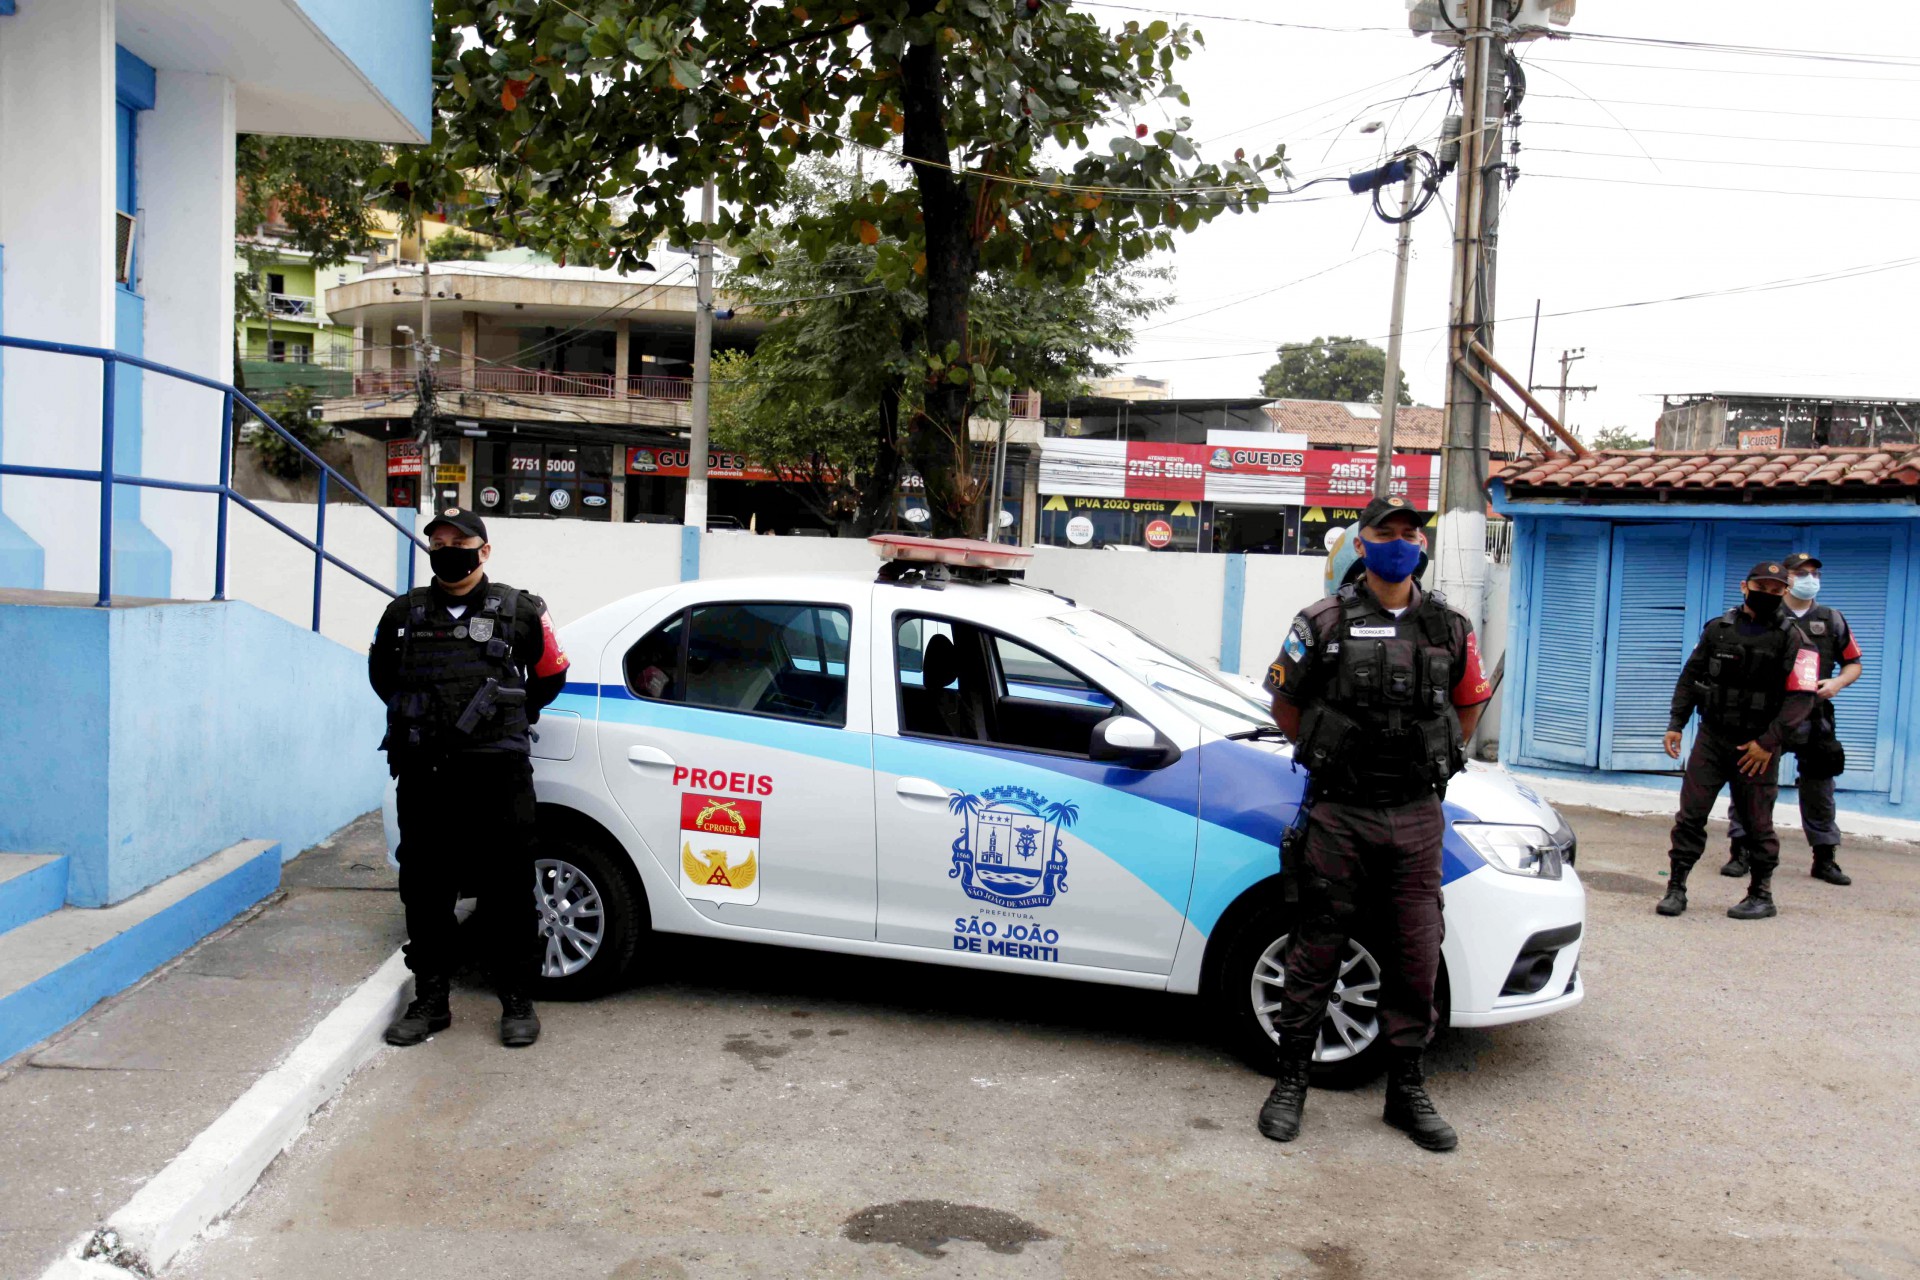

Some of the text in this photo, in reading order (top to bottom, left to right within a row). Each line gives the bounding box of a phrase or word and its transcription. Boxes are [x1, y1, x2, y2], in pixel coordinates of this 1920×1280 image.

[1750, 435, 1778, 446] GUEDES
[511, 457, 576, 472] 2751 5000
[659, 451, 746, 470] GUDES
[1233, 450, 1304, 466] GUEDES
[1128, 460, 1203, 479] 2751-5000
[1075, 498, 1165, 513] IPVA 2020 grátis
[1333, 510, 1358, 519] IPVA
[672, 766, 774, 796] PROEIS
[703, 822, 737, 834] CPROEIS
[967, 887, 1050, 908] SÃO JOÃO DE MERITI
[979, 908, 1034, 920] PREFEITURA
[954, 915, 1059, 945] SÃO JOÃO
[953, 936, 1059, 962] DE MERITI
